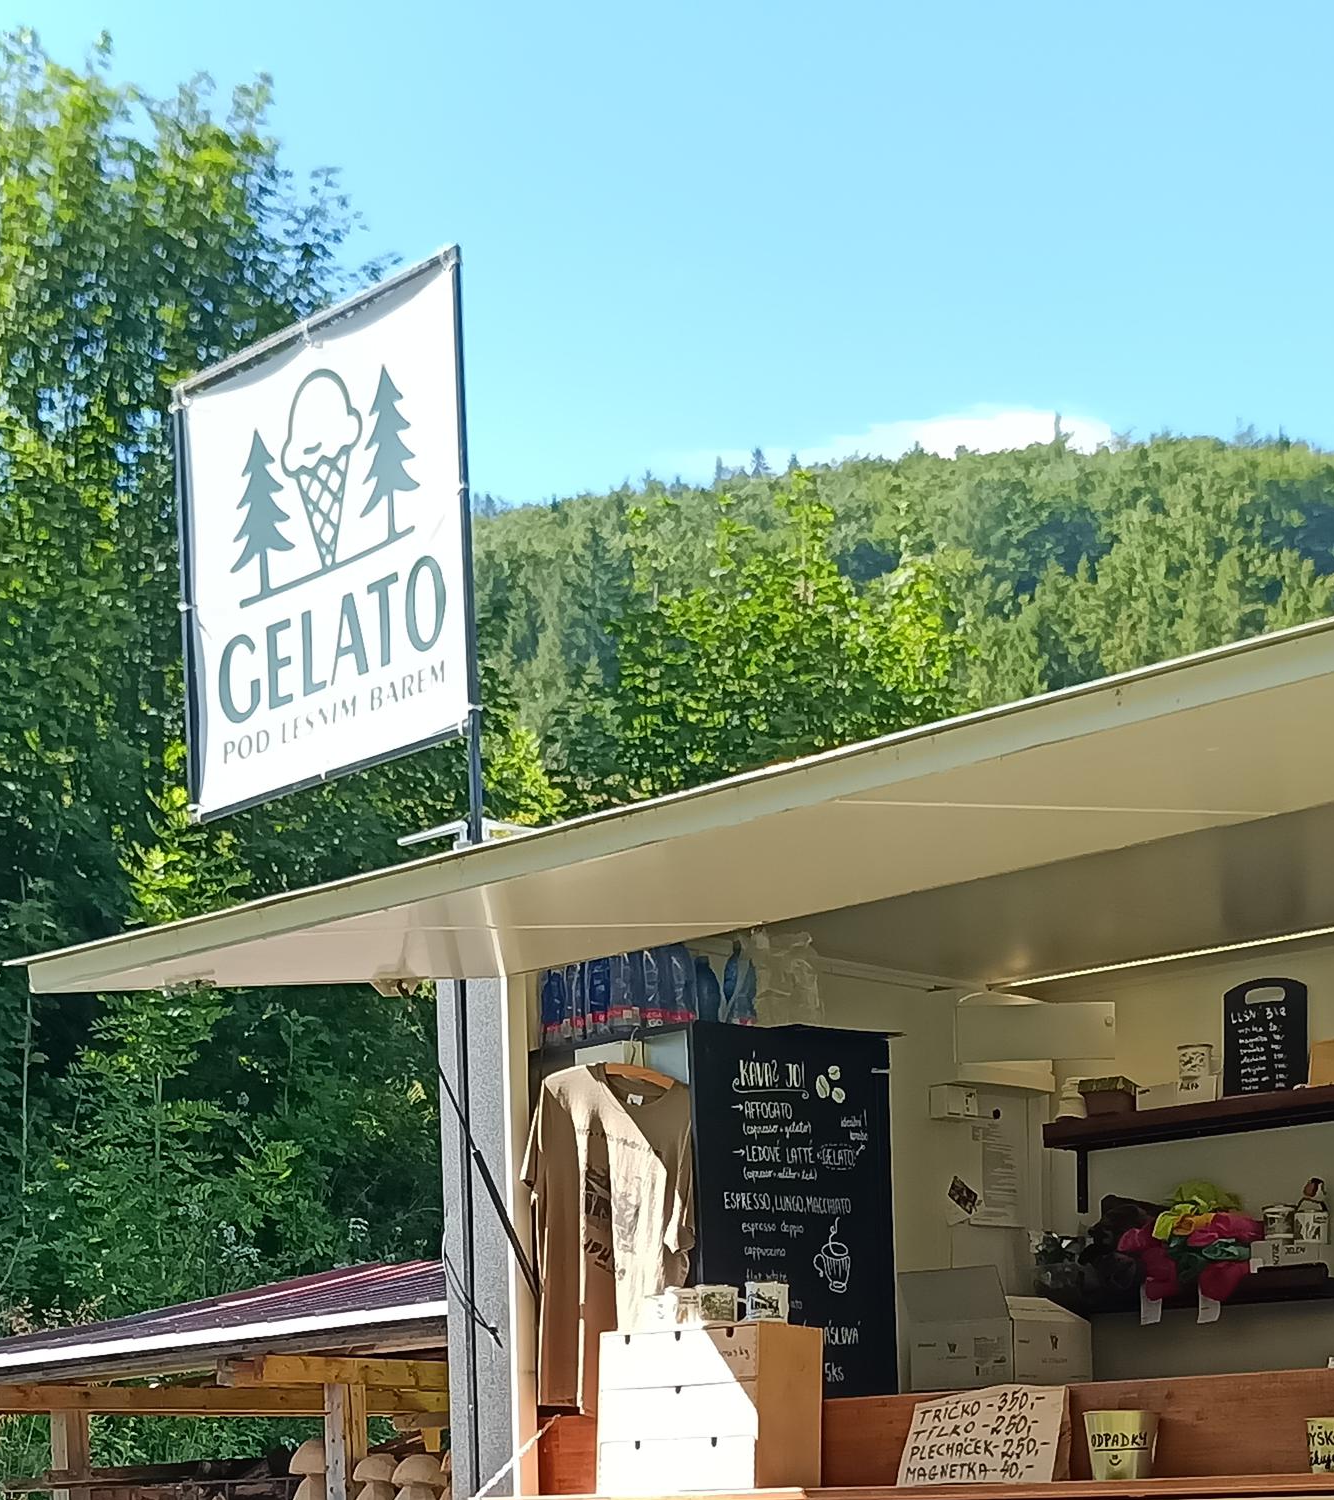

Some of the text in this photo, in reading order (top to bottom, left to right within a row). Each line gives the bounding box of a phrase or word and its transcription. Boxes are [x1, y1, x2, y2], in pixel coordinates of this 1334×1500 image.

[218, 556, 446, 724] GELATO
[224, 728, 269, 764] POD
[370, 660, 446, 712] BAREM
[739, 1050, 807, 1089] KÁVA? JO!
[744, 1100, 793, 1120] AFFOGATO
[745, 1139, 782, 1163] LEDOVÉ
[786, 1139, 816, 1165] LATTÉ
[741, 1222, 777, 1239] espresso
[920, 1400, 981, 1425] TRIČKO
[1090, 1431, 1149, 1450] ODPADKY
